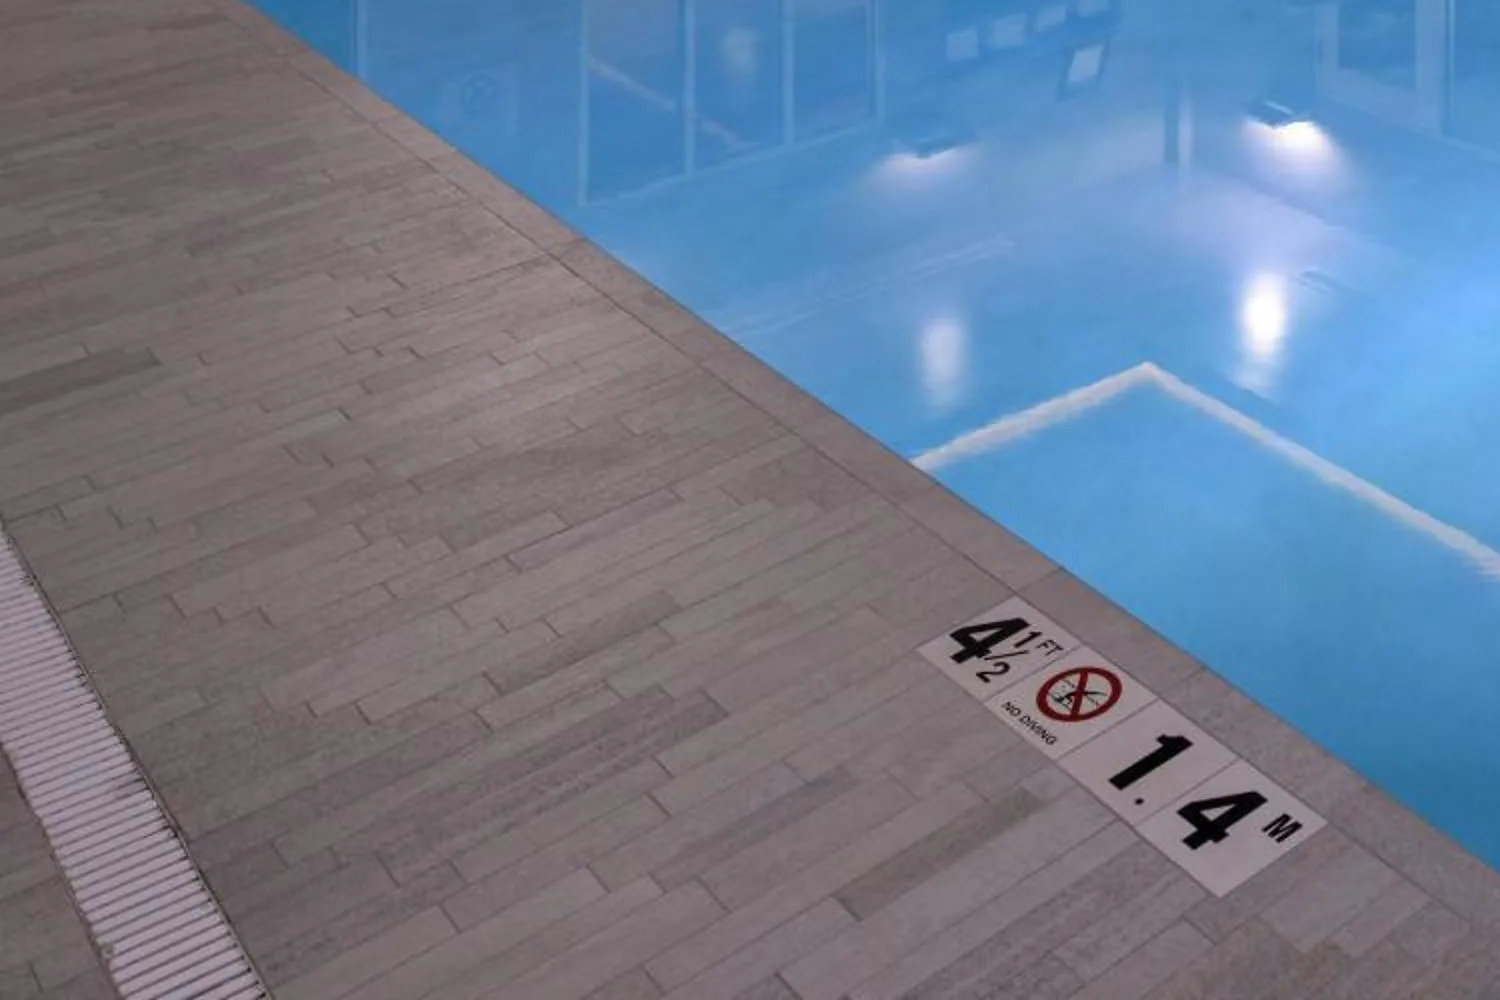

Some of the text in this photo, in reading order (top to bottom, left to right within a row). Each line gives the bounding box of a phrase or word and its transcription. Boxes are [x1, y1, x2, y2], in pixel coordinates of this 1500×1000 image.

[950, 617, 1031, 665] 4
[1035, 639, 1065, 657] FT
[1001, 700, 1059, 747] NO DIVING
[1261, 812, 1304, 845] M
